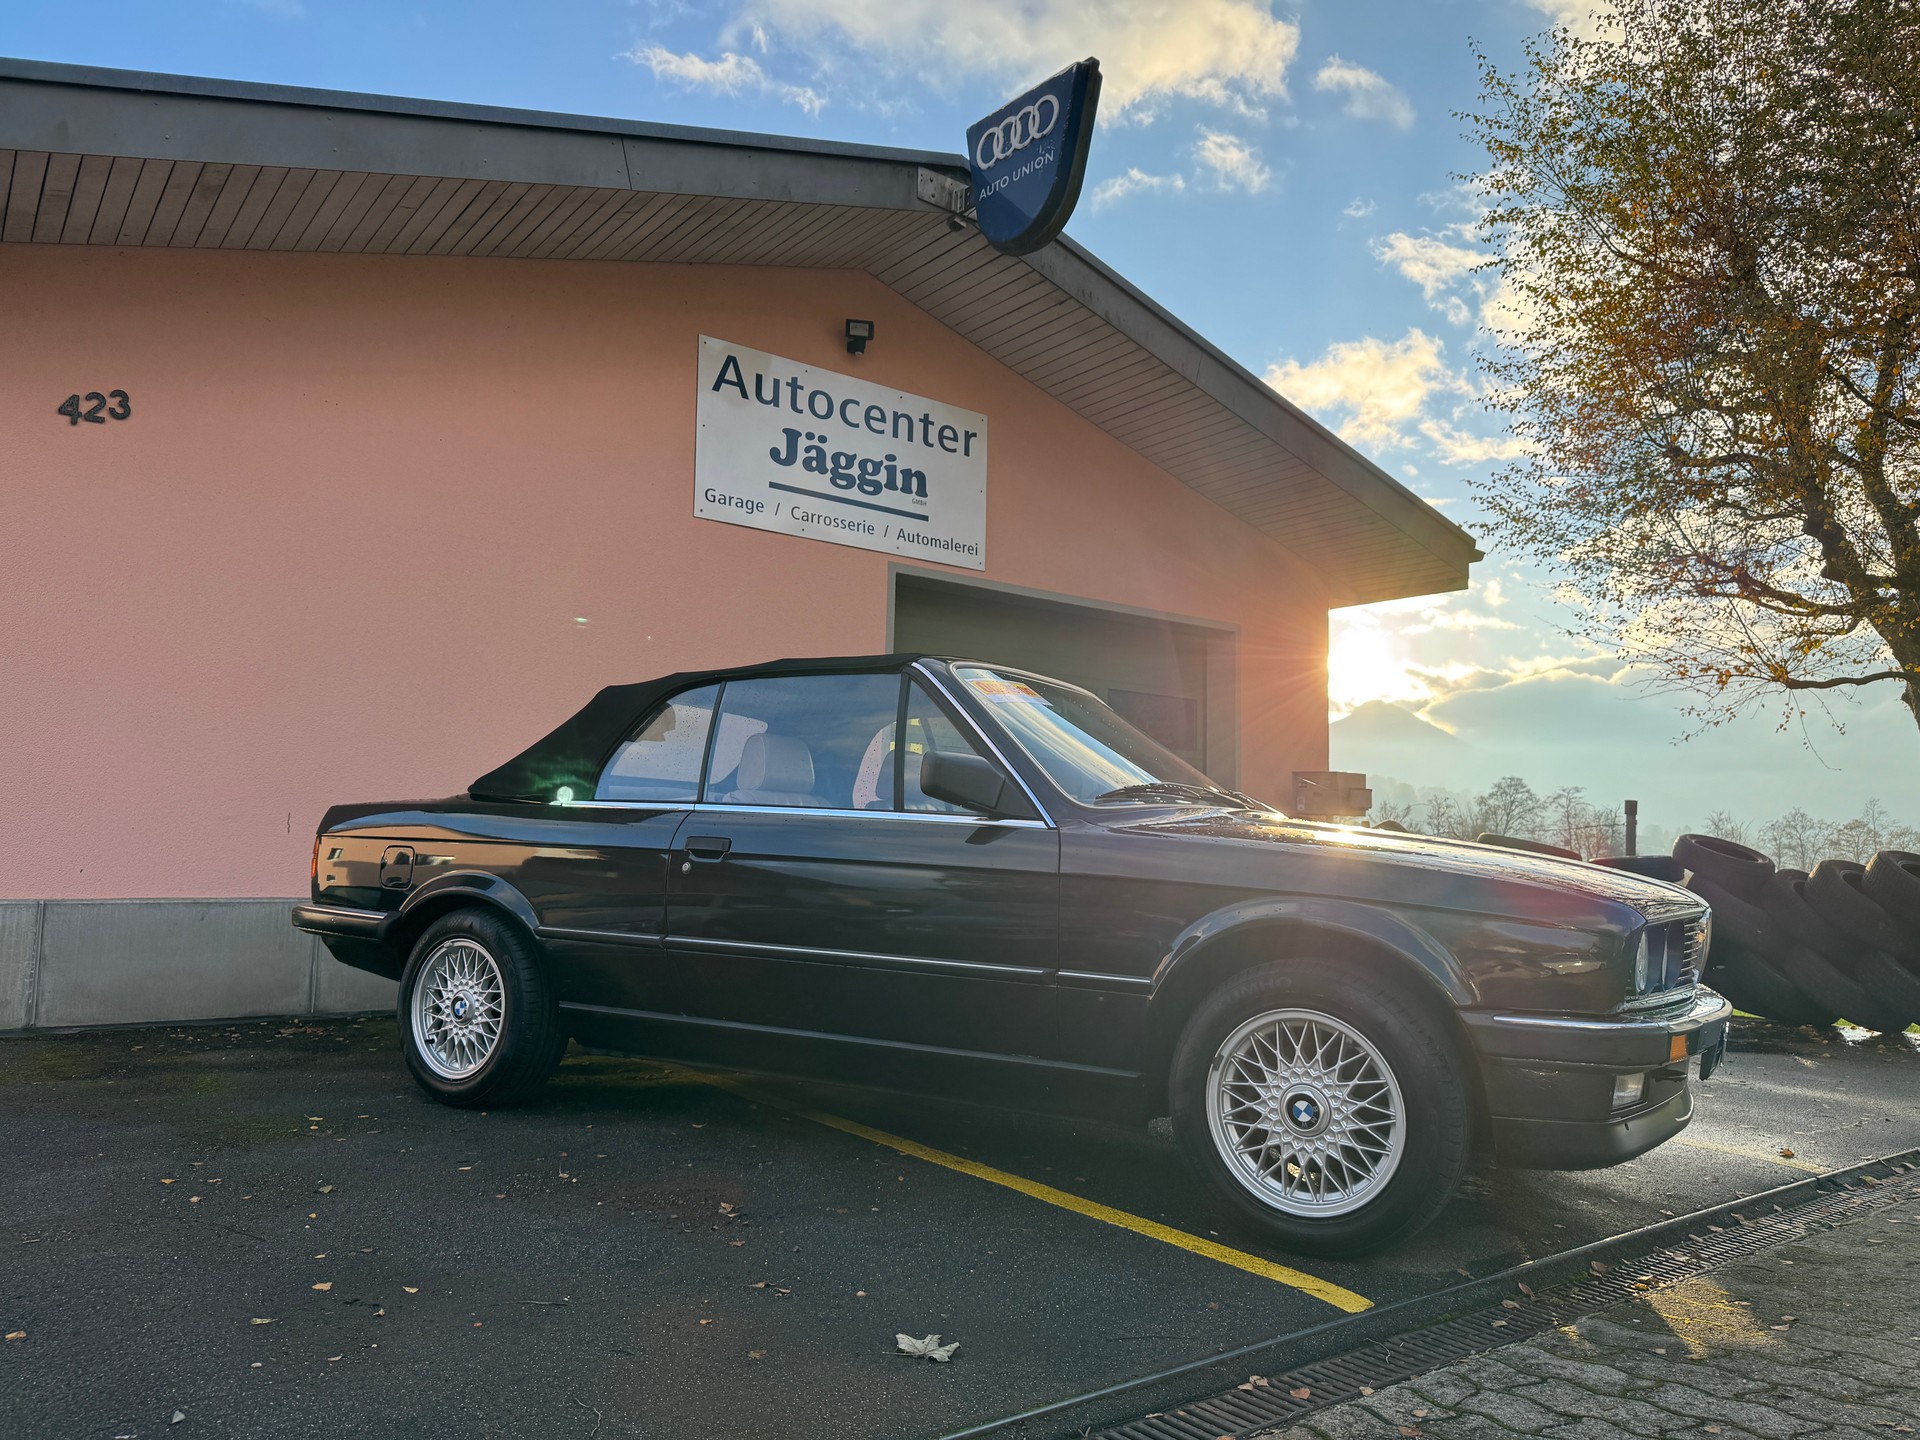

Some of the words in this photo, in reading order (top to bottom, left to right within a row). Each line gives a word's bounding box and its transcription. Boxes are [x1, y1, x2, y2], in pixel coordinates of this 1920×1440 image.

[978, 176, 1009, 201] AUTO
[1012, 150, 1055, 181] UNION
[58, 389, 131, 425] 423
[711, 354, 978, 457] Autocenter
[769, 427, 929, 498] Jäggin
[704, 488, 765, 514] Garage
[774, 502, 781, 516] /
[790, 506, 875, 535] Carrosserie
[883, 525, 889, 538] /
[896, 528, 979, 556] Automalerei
